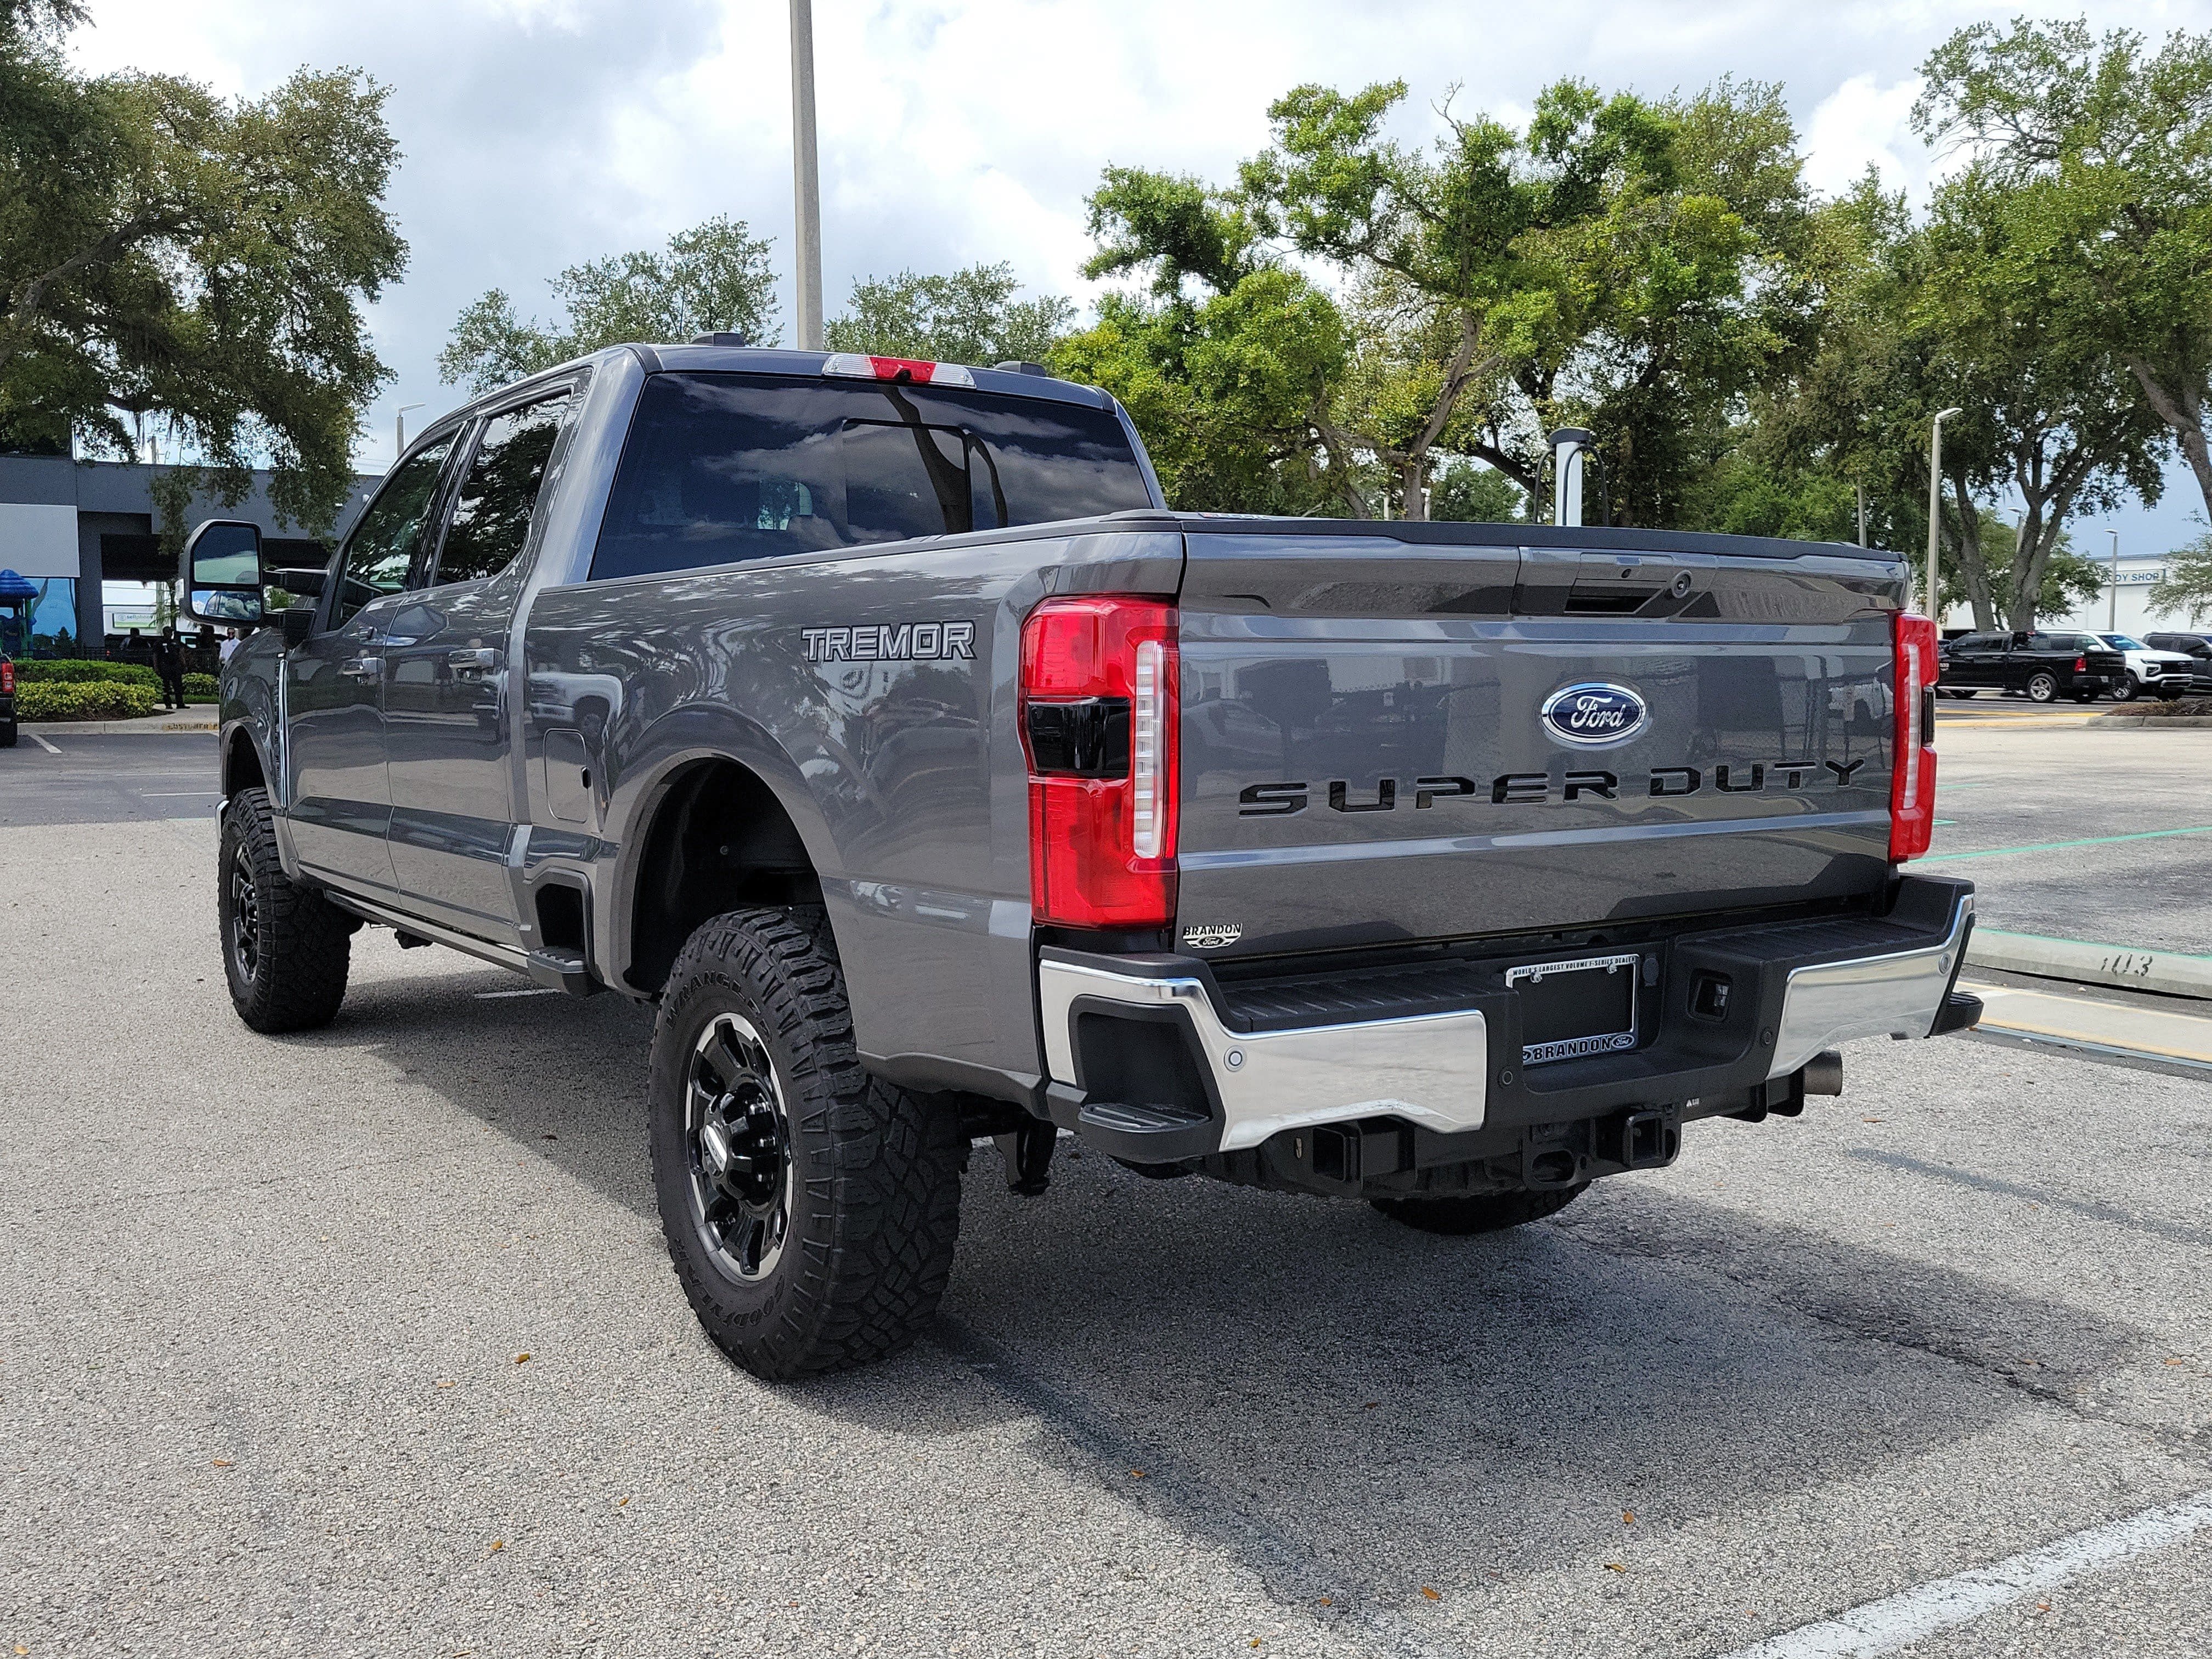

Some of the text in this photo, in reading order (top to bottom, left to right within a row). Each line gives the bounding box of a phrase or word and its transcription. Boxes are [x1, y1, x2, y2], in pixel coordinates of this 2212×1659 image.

[2131, 572, 2159, 581] SHOP
[802, 620, 977, 662] TREMOR
[1571, 696, 1626, 728] Ford
[1239, 759, 1865, 819] SUPER DUTY
[1183, 924, 1241, 936] BRANDON
[1202, 937, 1220, 945] Ford
[1539, 964, 1564, 973] LARGEST
[1565, 961, 1588, 970] VOLUME
[1589, 958, 1613, 967] F-SERIES
[1615, 956, 1635, 964] DEALER
[1532, 1036, 1611, 1061] BRANDON
